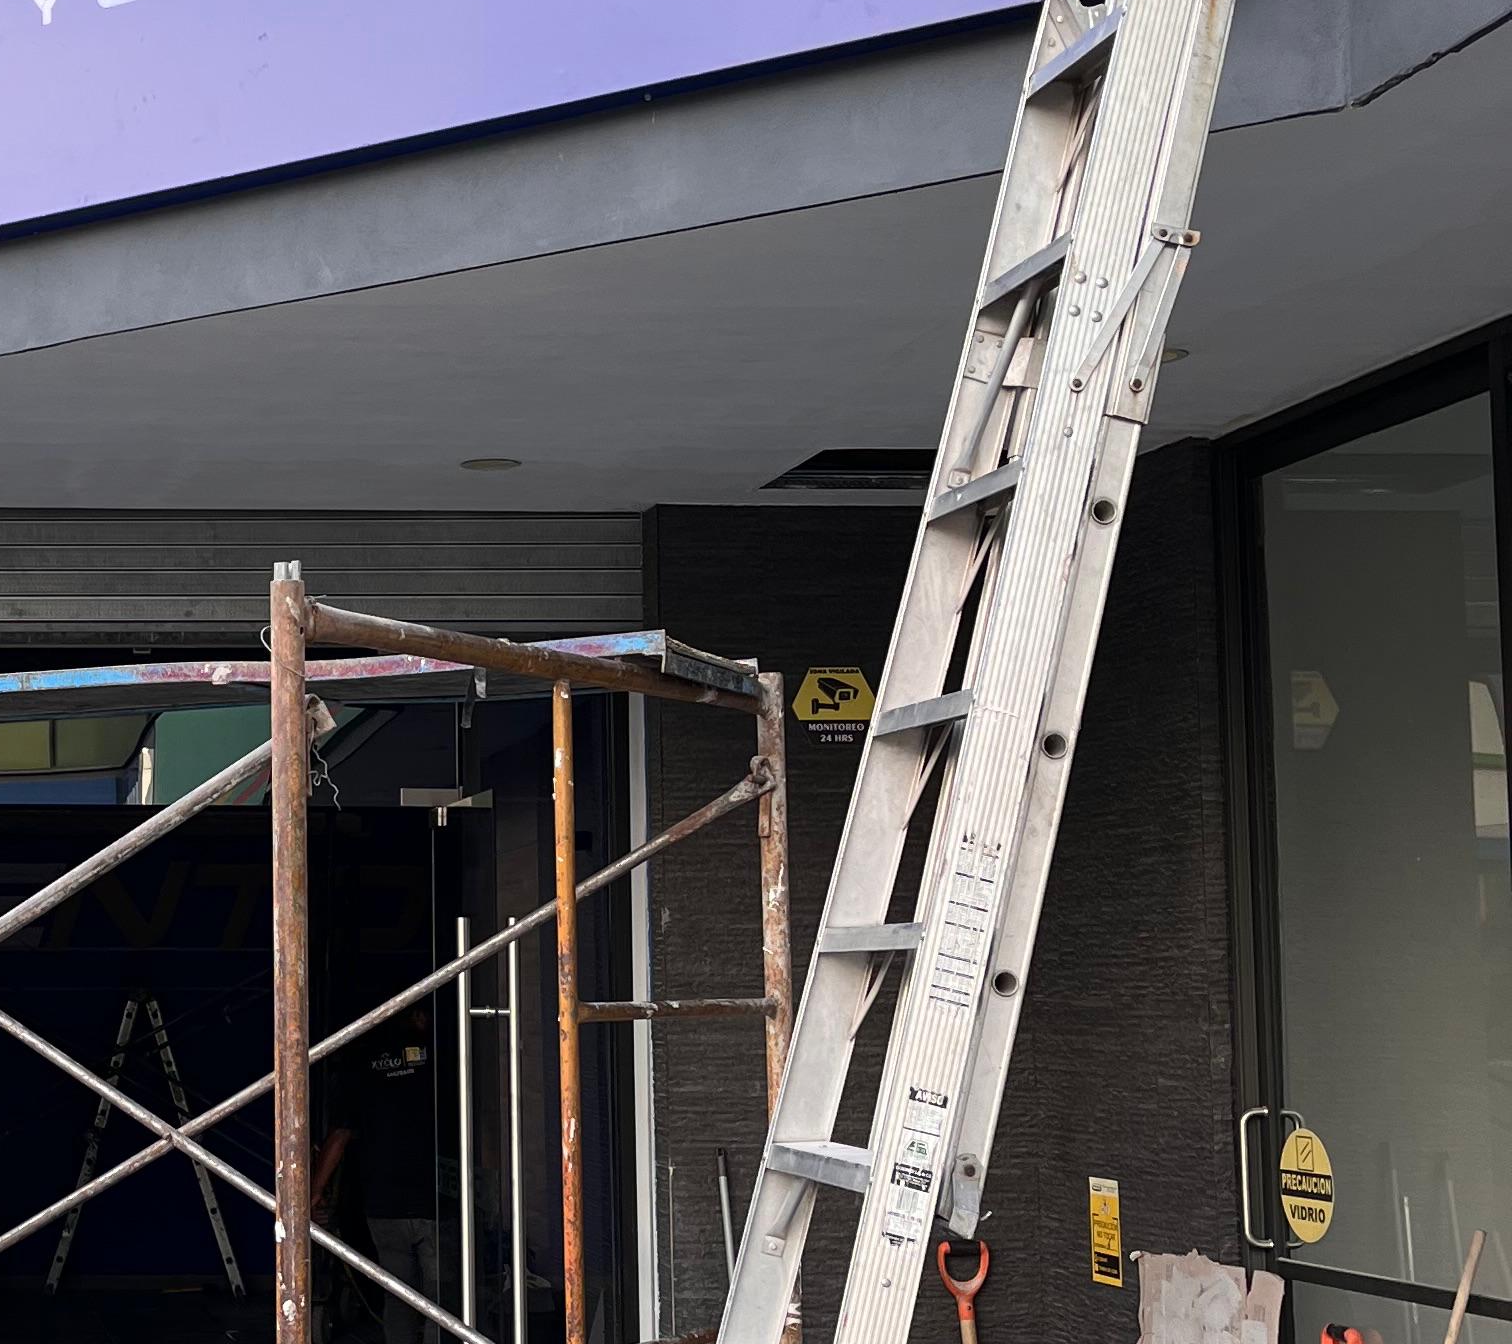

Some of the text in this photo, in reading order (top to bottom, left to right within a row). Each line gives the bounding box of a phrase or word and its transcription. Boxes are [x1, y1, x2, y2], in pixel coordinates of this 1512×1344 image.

[808, 723, 865, 731] MONITOREO
[820, 734, 854, 742] 24 HRS
[1281, 1173, 1332, 1195] PRECAUCION
[1289, 1203, 1326, 1224] VIDRIO
